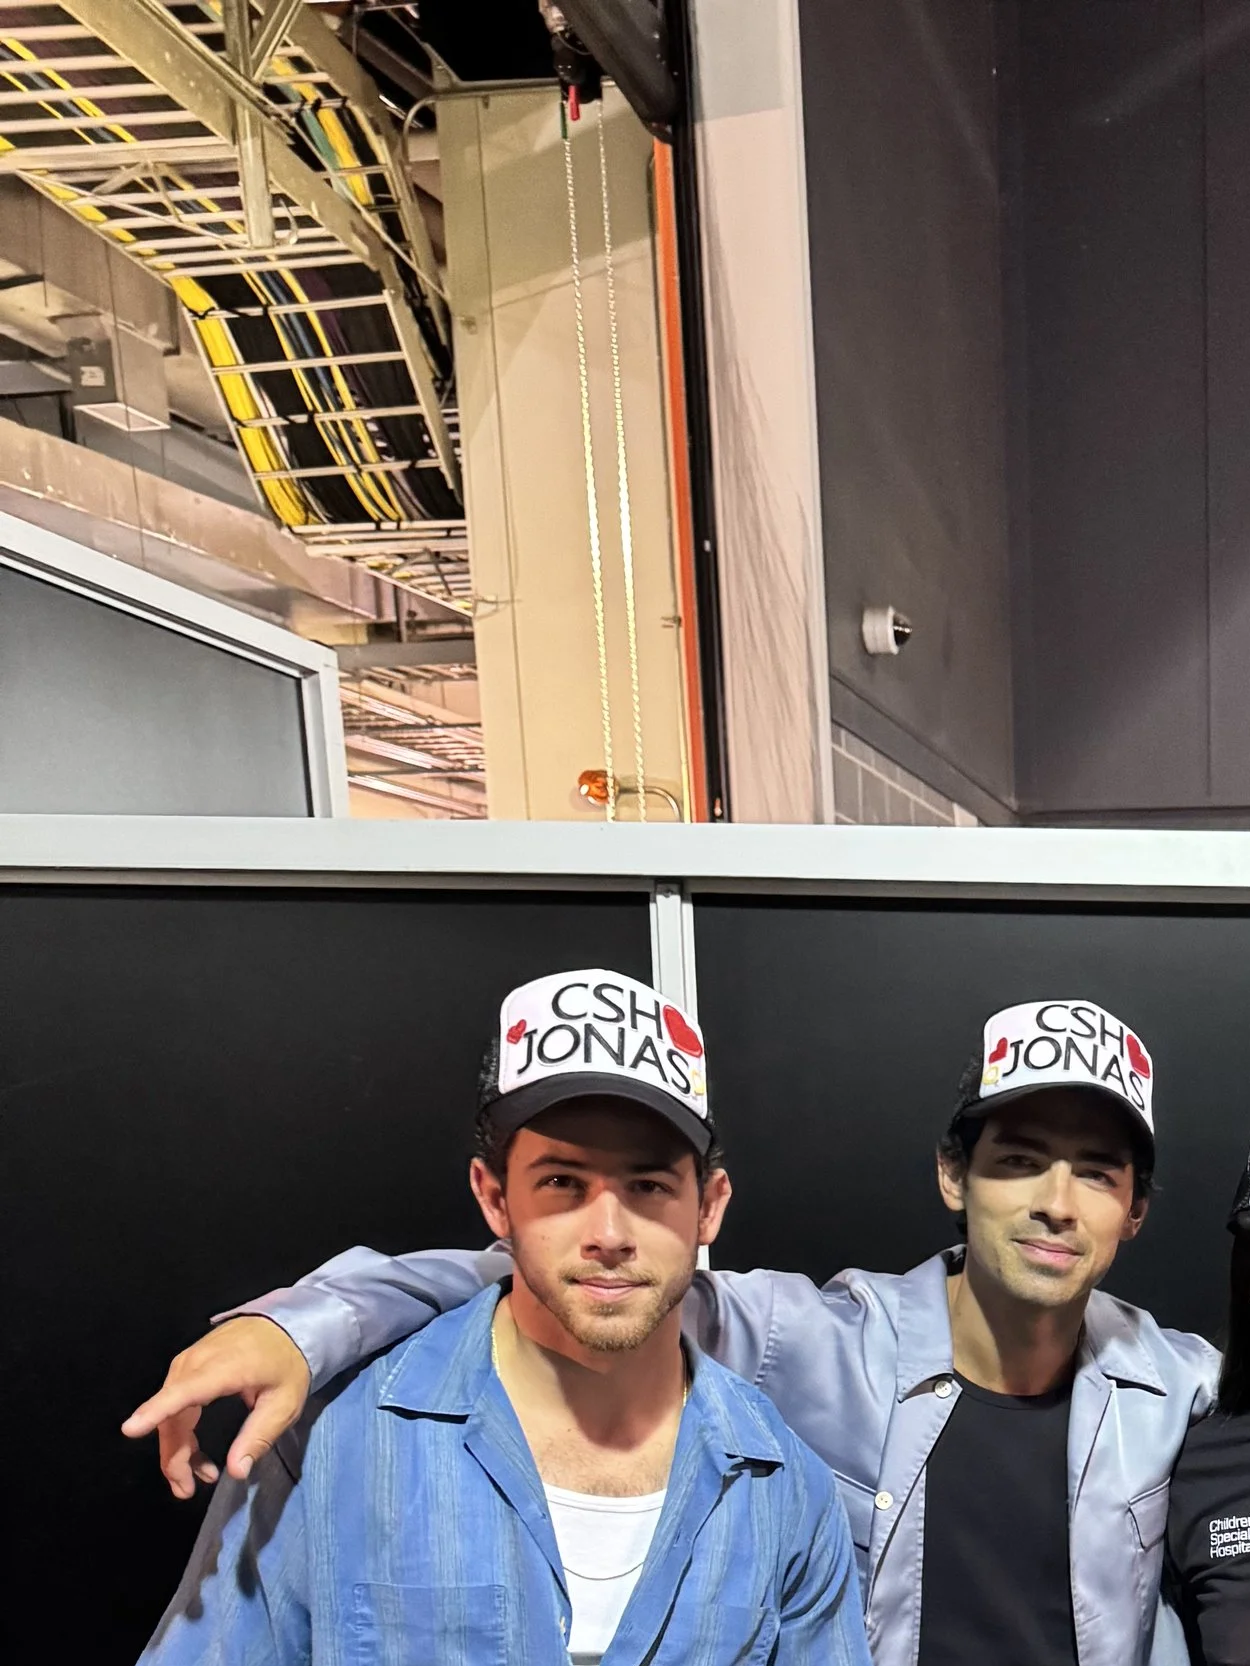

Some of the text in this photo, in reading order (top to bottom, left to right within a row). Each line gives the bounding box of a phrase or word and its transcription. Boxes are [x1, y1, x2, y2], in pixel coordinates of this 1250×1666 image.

[551, 982, 664, 1042] CSH
[1035, 1004, 1124, 1058] CSH
[516, 1022, 691, 1095] JONAS
[1002, 1035, 1145, 1111] JONAS
